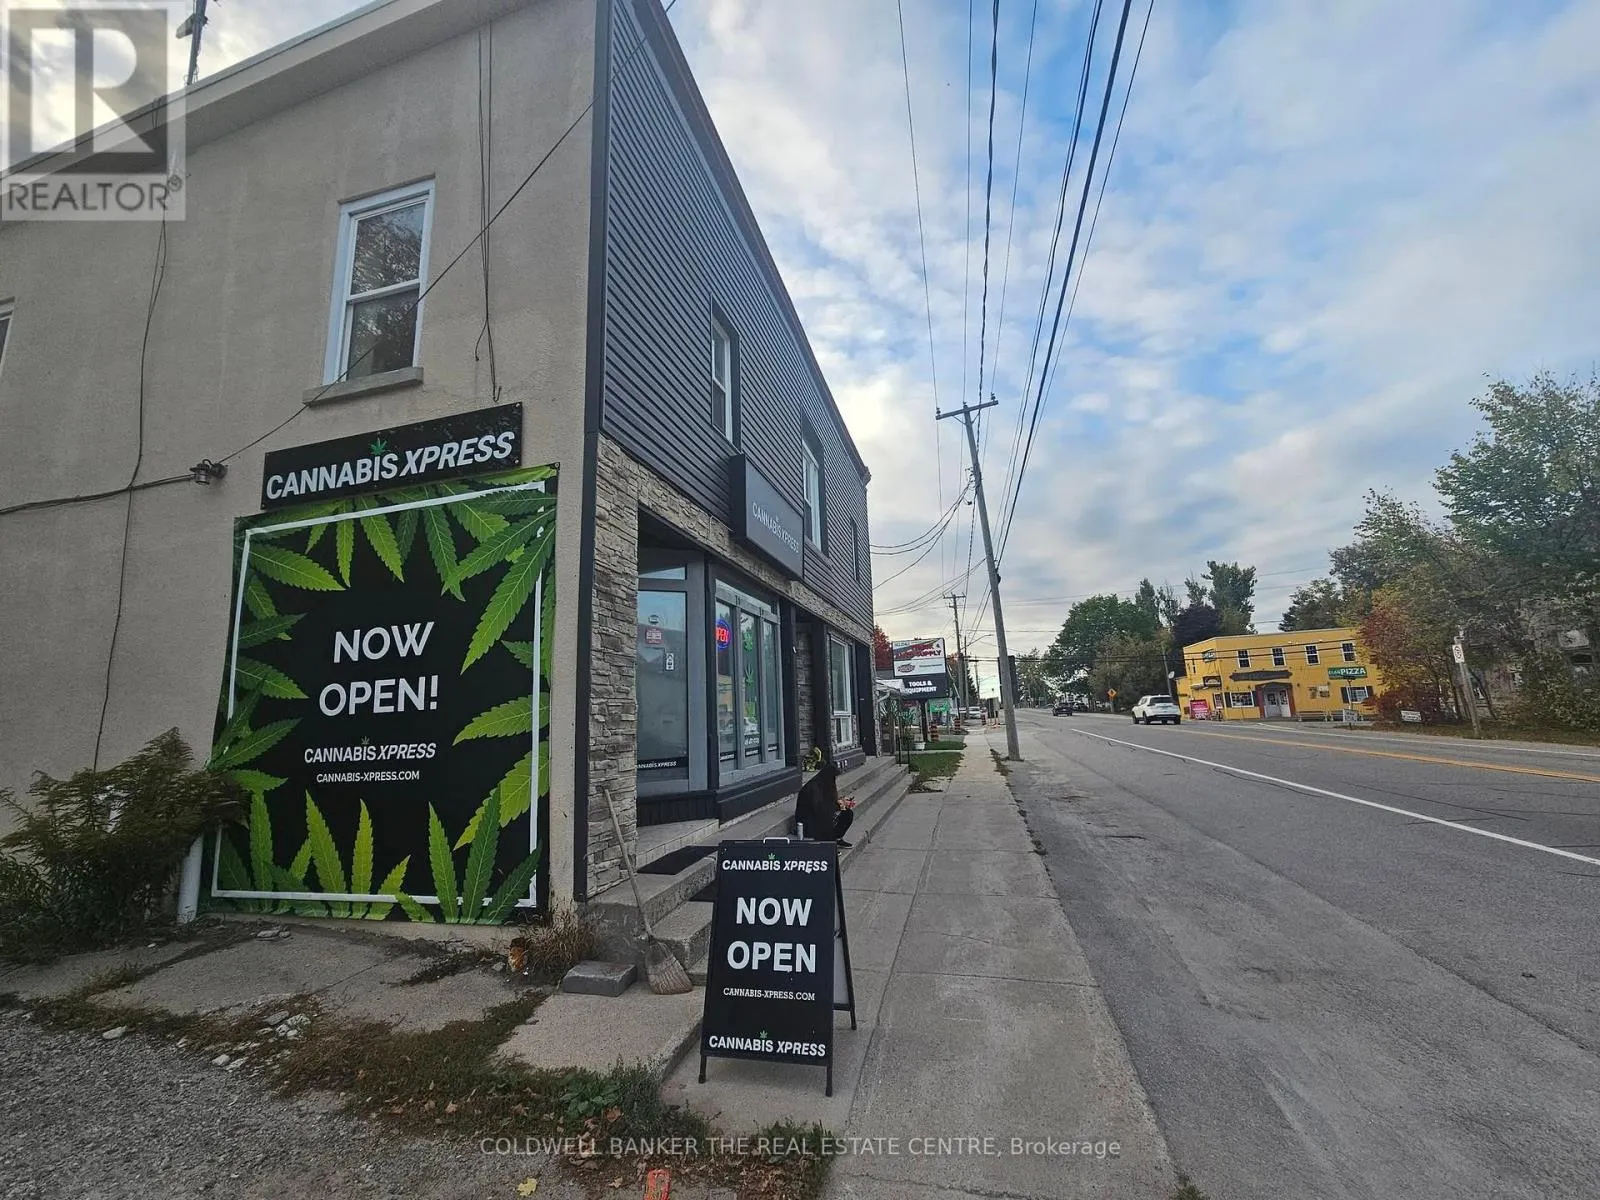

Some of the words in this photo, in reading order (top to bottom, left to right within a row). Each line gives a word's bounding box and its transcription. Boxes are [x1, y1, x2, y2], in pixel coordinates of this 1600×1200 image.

[266, 453, 398, 499] CANNABIS
[400, 431, 515, 476] XPRESS
[753, 502, 781, 538] CANNABIS
[333, 621, 435, 663] NOW
[1340, 667, 1366, 675] PIZZA
[319, 675, 438, 717] OPEN!
[304, 745, 377, 763] CANNABIS
[377, 743, 437, 760] XPRESS
[316, 770, 420, 783] CANNABIS-XPRESS.COM
[722, 859, 780, 871] CANNABIS
[783, 860, 828, 872] XPRESS
[736, 897, 813, 926] NOW
[727, 941, 816, 973] OPEN
[723, 987, 815, 1001] CANNABIS-XPRESS.COM
[709, 1035, 774, 1053] CANNABIS
[776, 1041, 826, 1057] XPRESS
